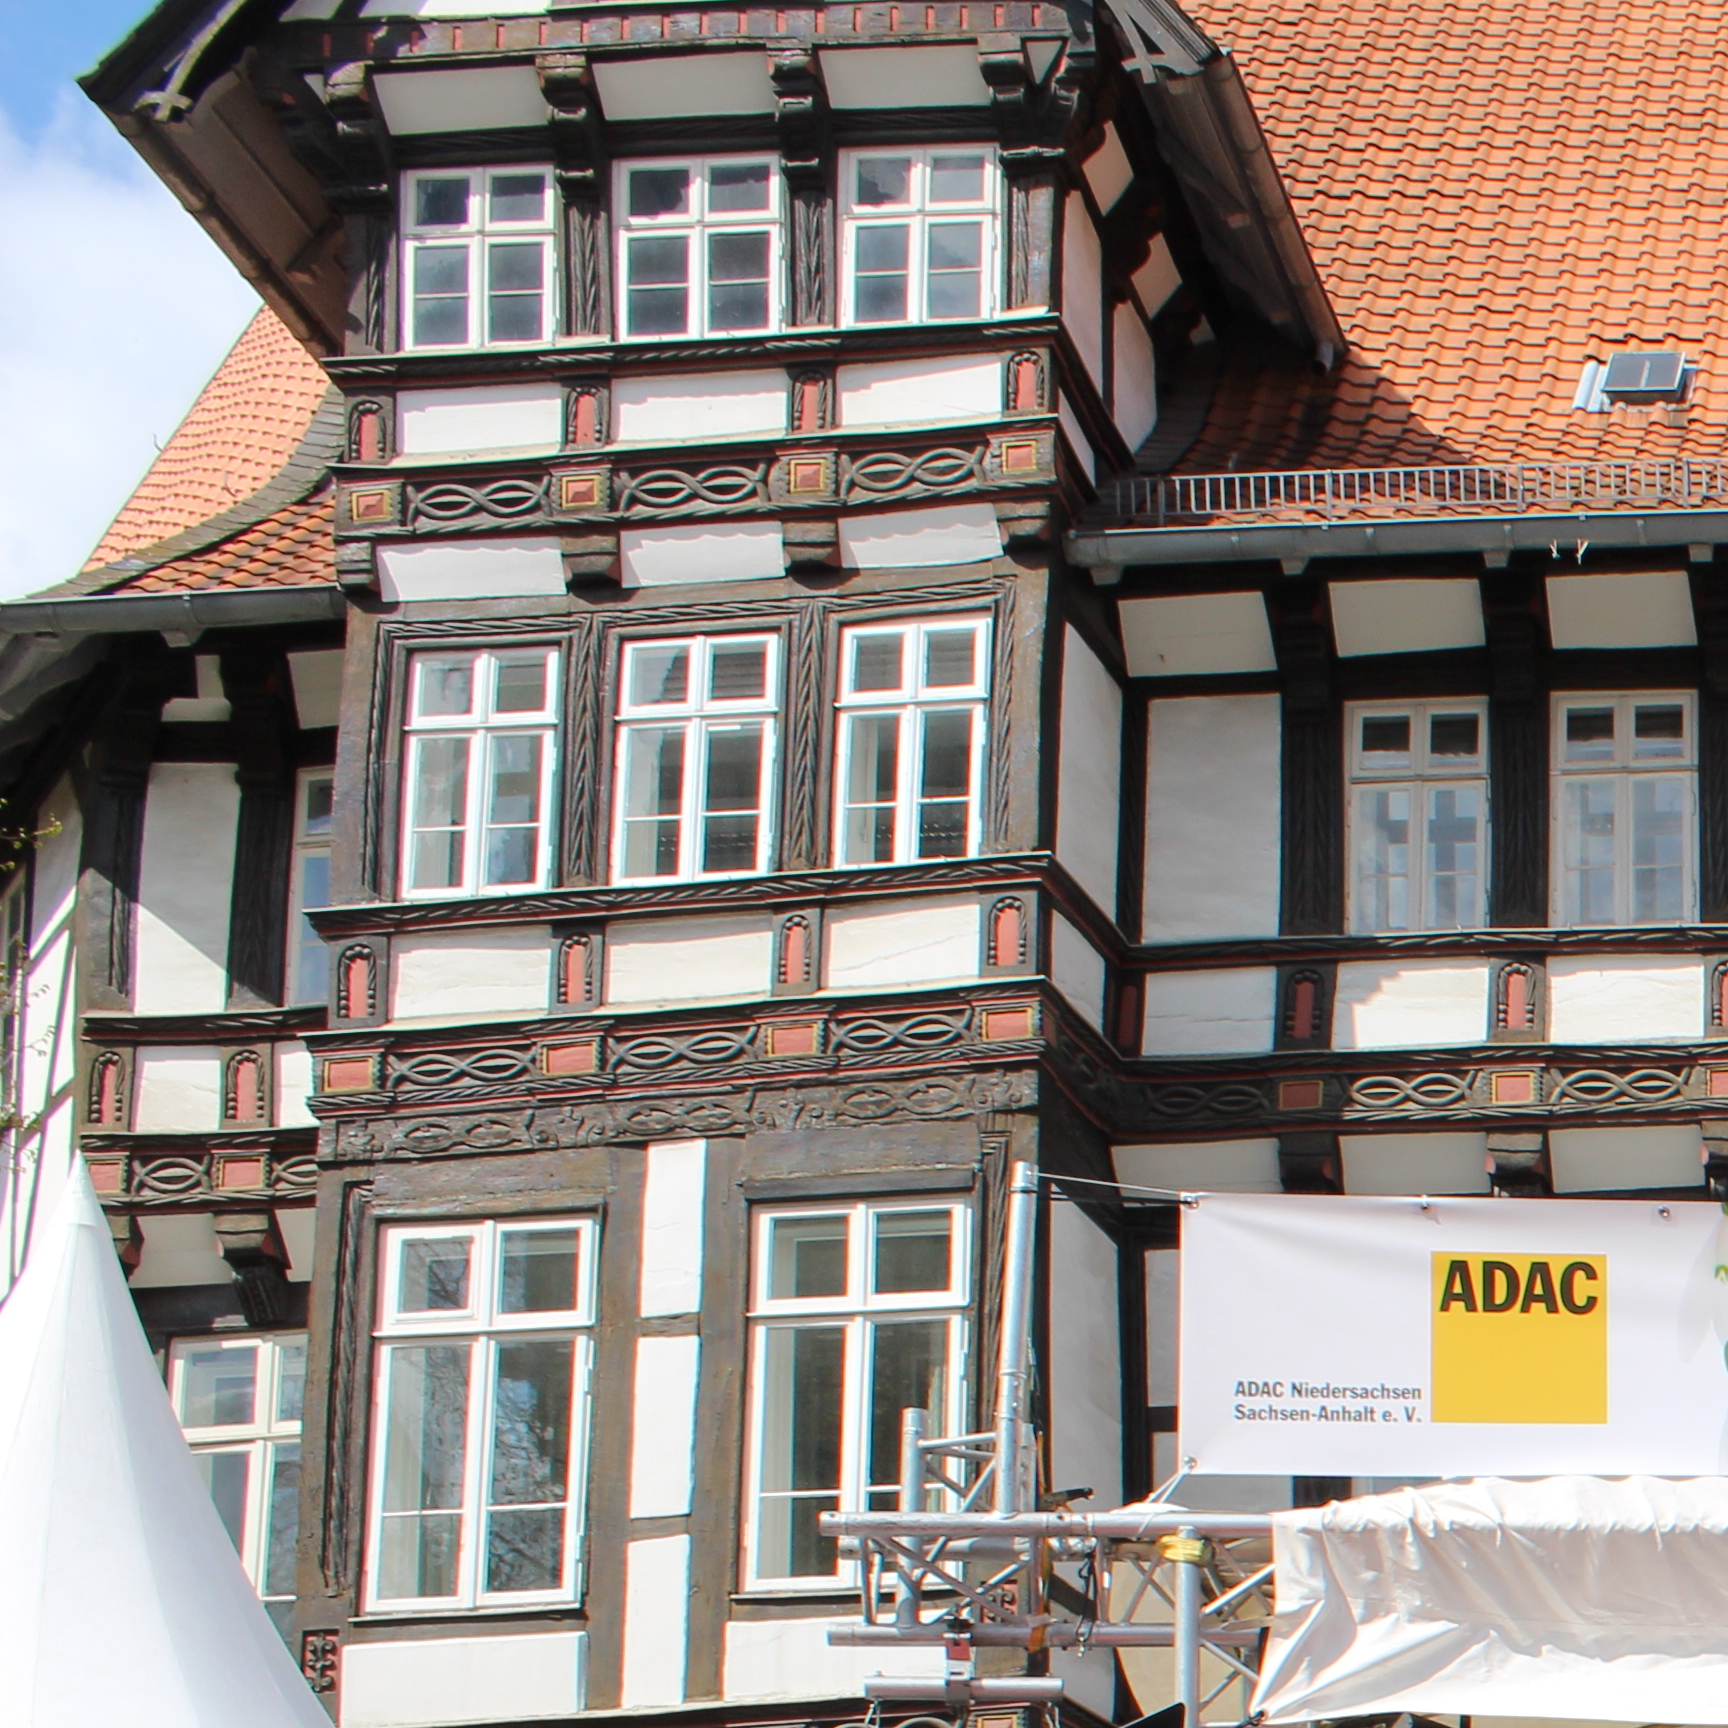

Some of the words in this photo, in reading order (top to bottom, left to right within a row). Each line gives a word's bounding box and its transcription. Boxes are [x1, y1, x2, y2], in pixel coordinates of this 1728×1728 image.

[1439, 1260, 1599, 1314] ADAC
[1234, 1381, 1284, 1397] ADAC
[1291, 1382, 1422, 1400] Niedersachsen
[1234, 1404, 1377, 1423] Sachsen-Anhalt
[1382, 1410, 1398, 1422] e.
[1404, 1407, 1422, 1423] V.
